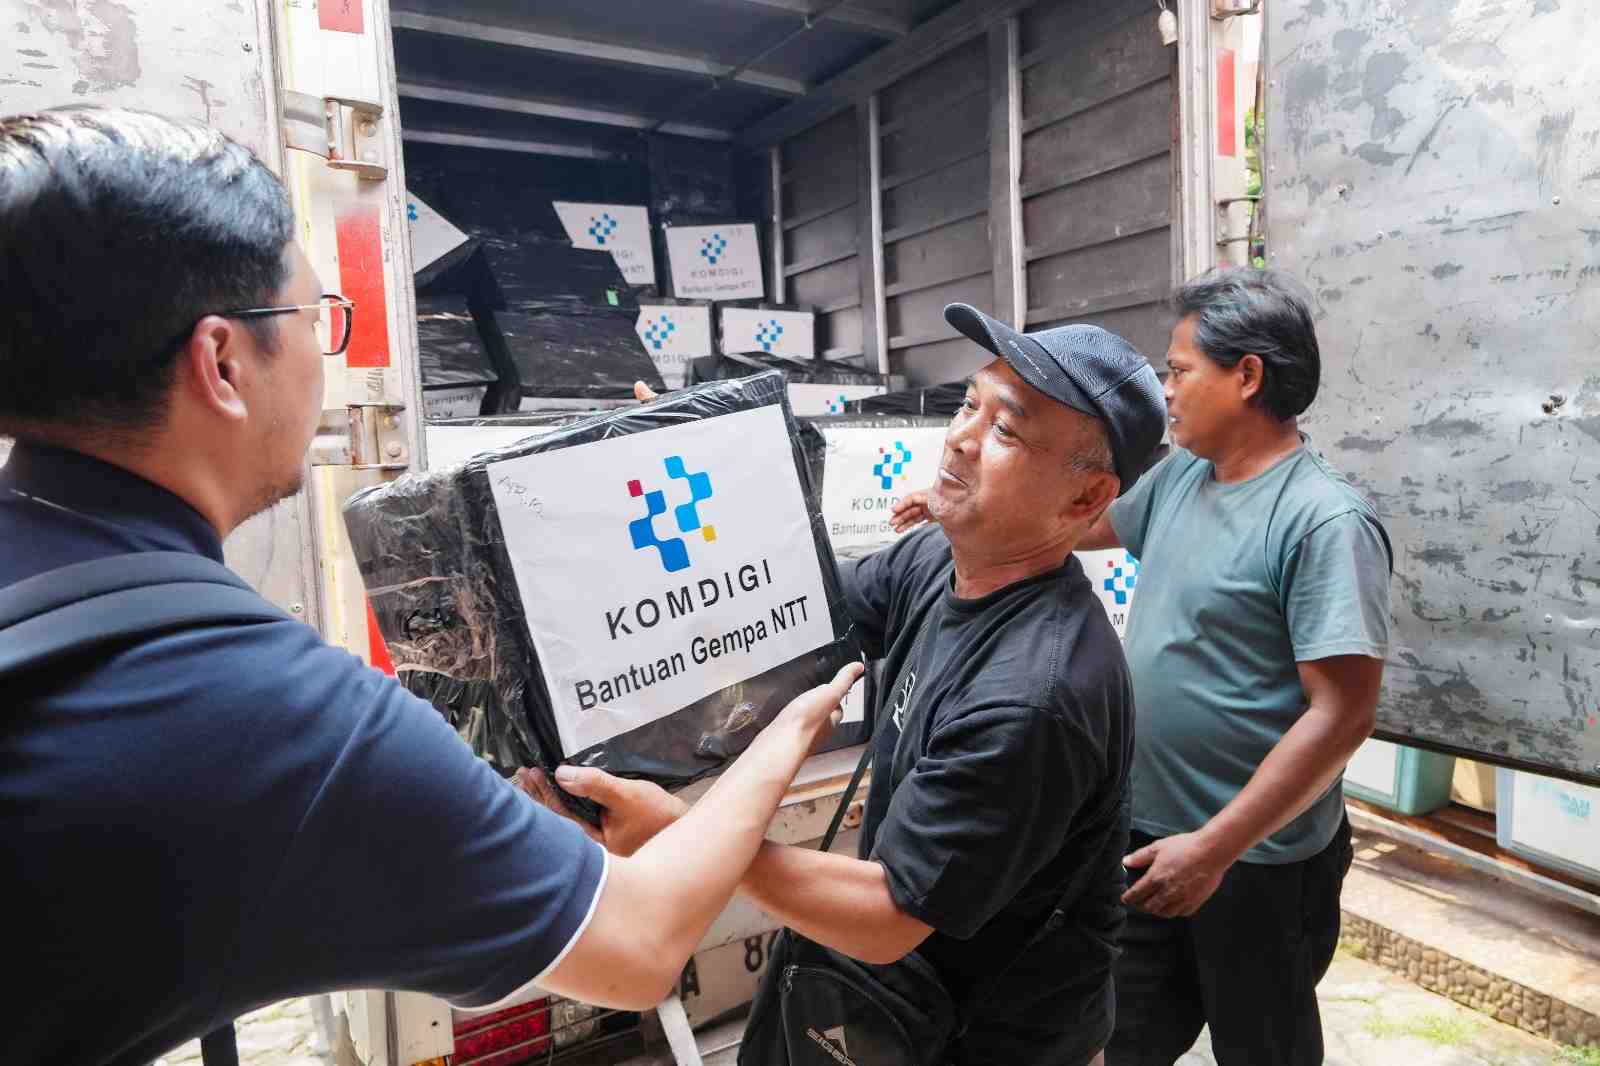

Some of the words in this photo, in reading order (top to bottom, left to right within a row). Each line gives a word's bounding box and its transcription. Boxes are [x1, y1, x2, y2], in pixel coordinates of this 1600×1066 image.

[832, 521, 877, 536] Bantuan
[851, 497, 900, 511] KOMD
[605, 558, 773, 641] KOMDIGI
[575, 651, 686, 711] Bantuan
[691, 618, 769, 665] Gempa
[770, 596, 809, 635] NTT
